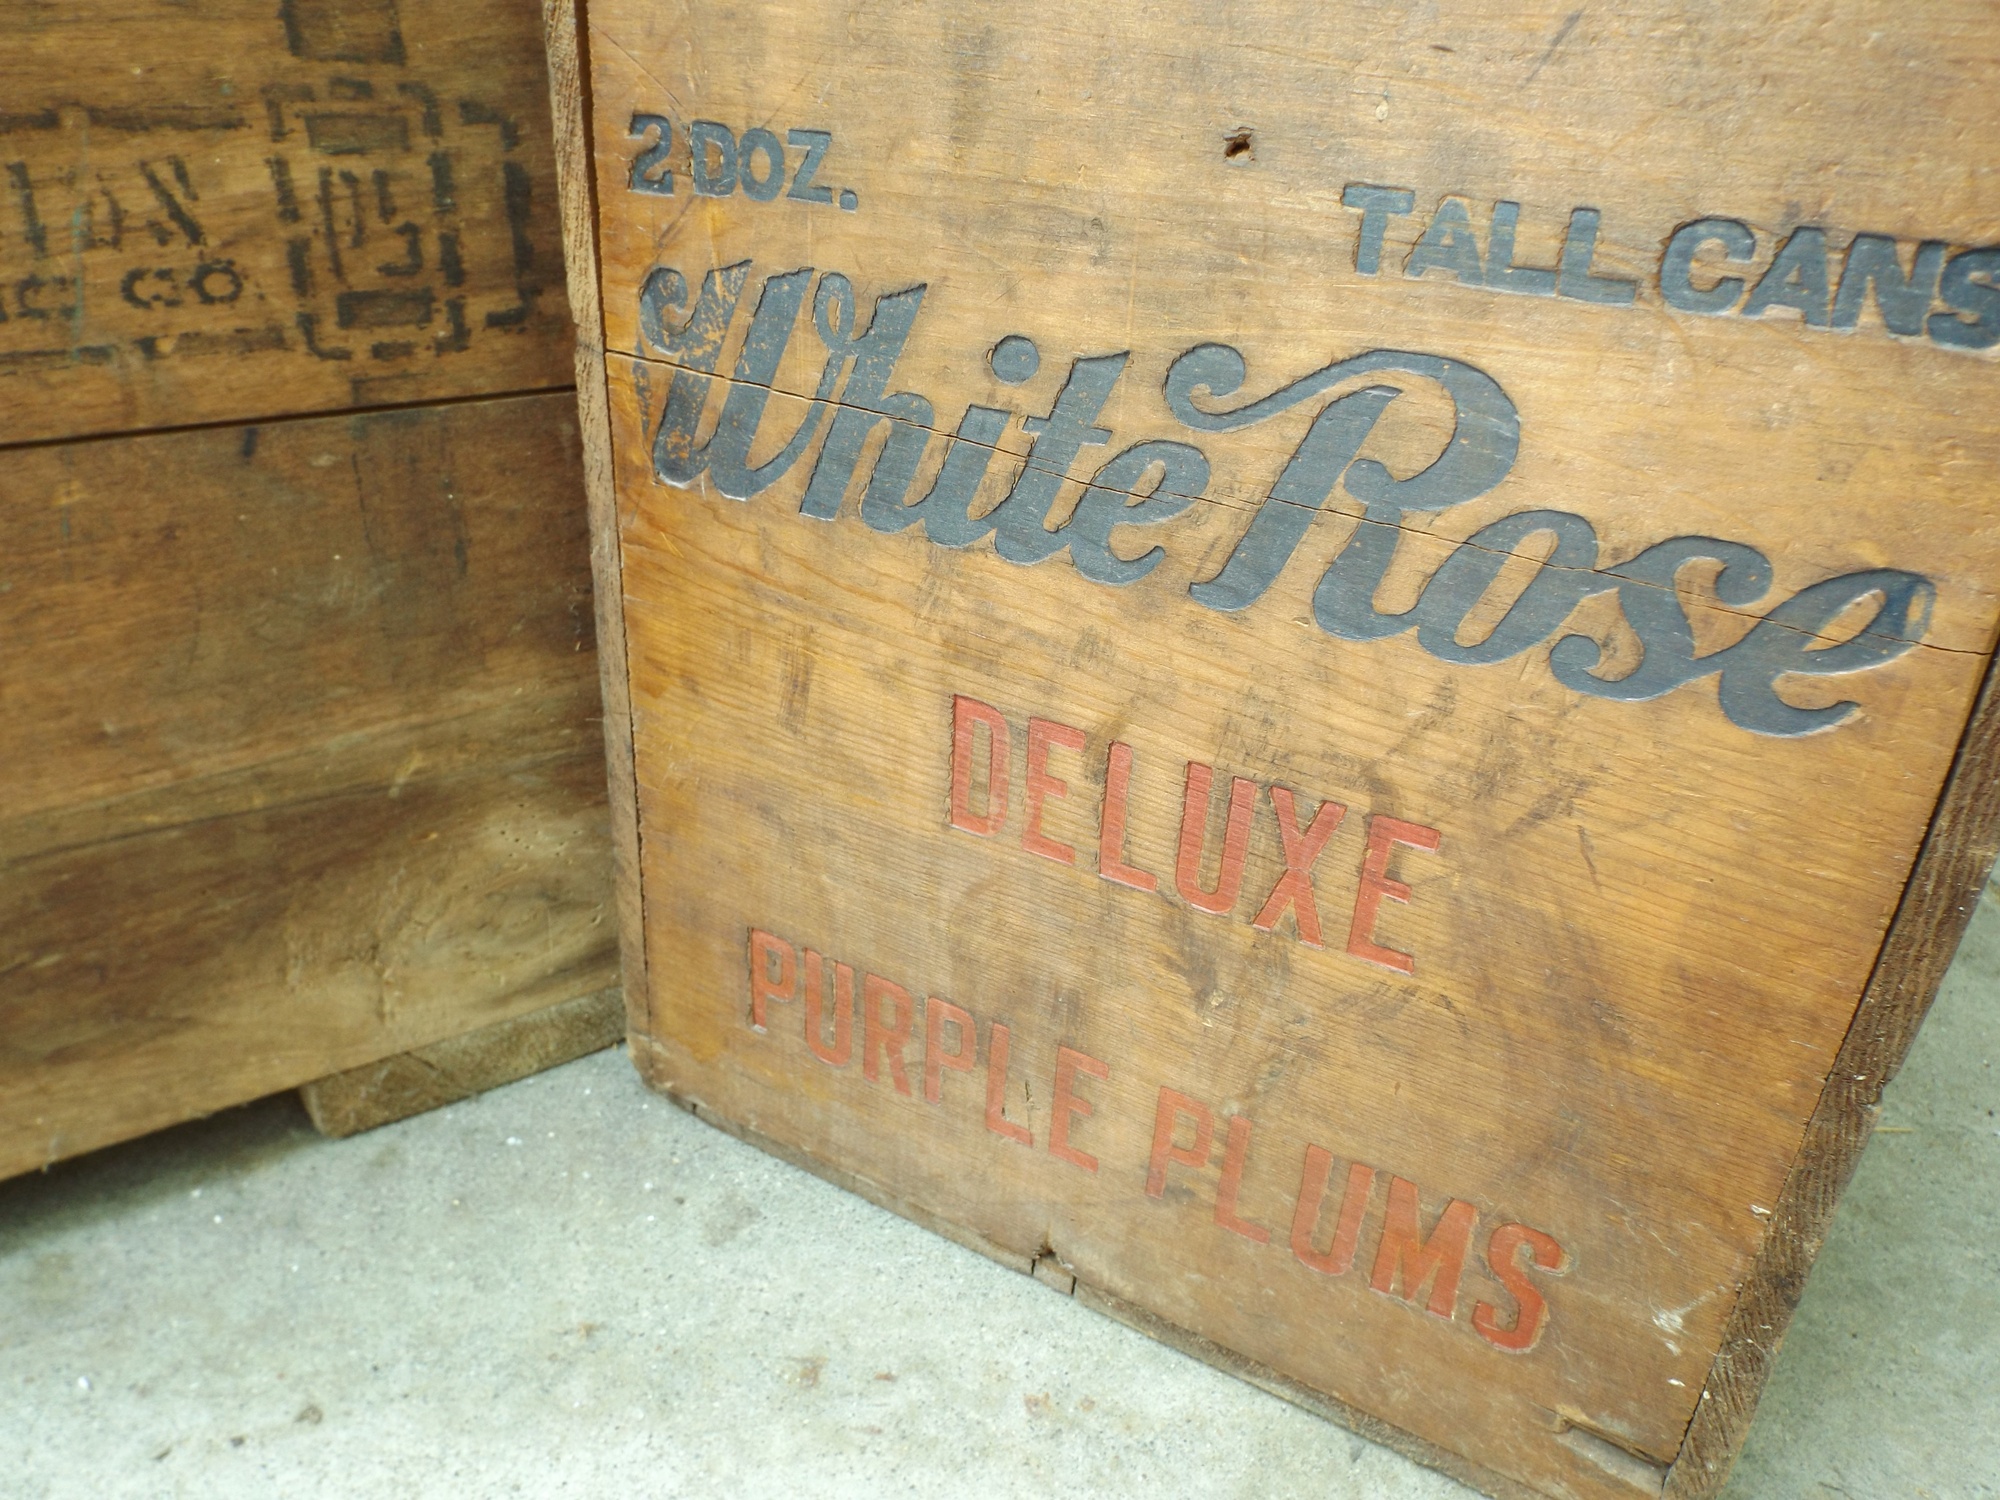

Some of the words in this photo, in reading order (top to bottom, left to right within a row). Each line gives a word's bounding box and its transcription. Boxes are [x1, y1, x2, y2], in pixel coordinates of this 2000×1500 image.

[629, 113, 674, 196] 2
[691, 119, 859, 212] DOZ.
[1342, 182, 1640, 308] TALL
[1659, 215, 2000, 352] CANS
[633, 258, 1211, 587] White
[1164, 343, 1937, 740] Rose
[947, 694, 1441, 975] DELUXE
[747, 926, 1110, 1173] PURPLE
[1143, 1085, 1569, 1354] PLUMS
